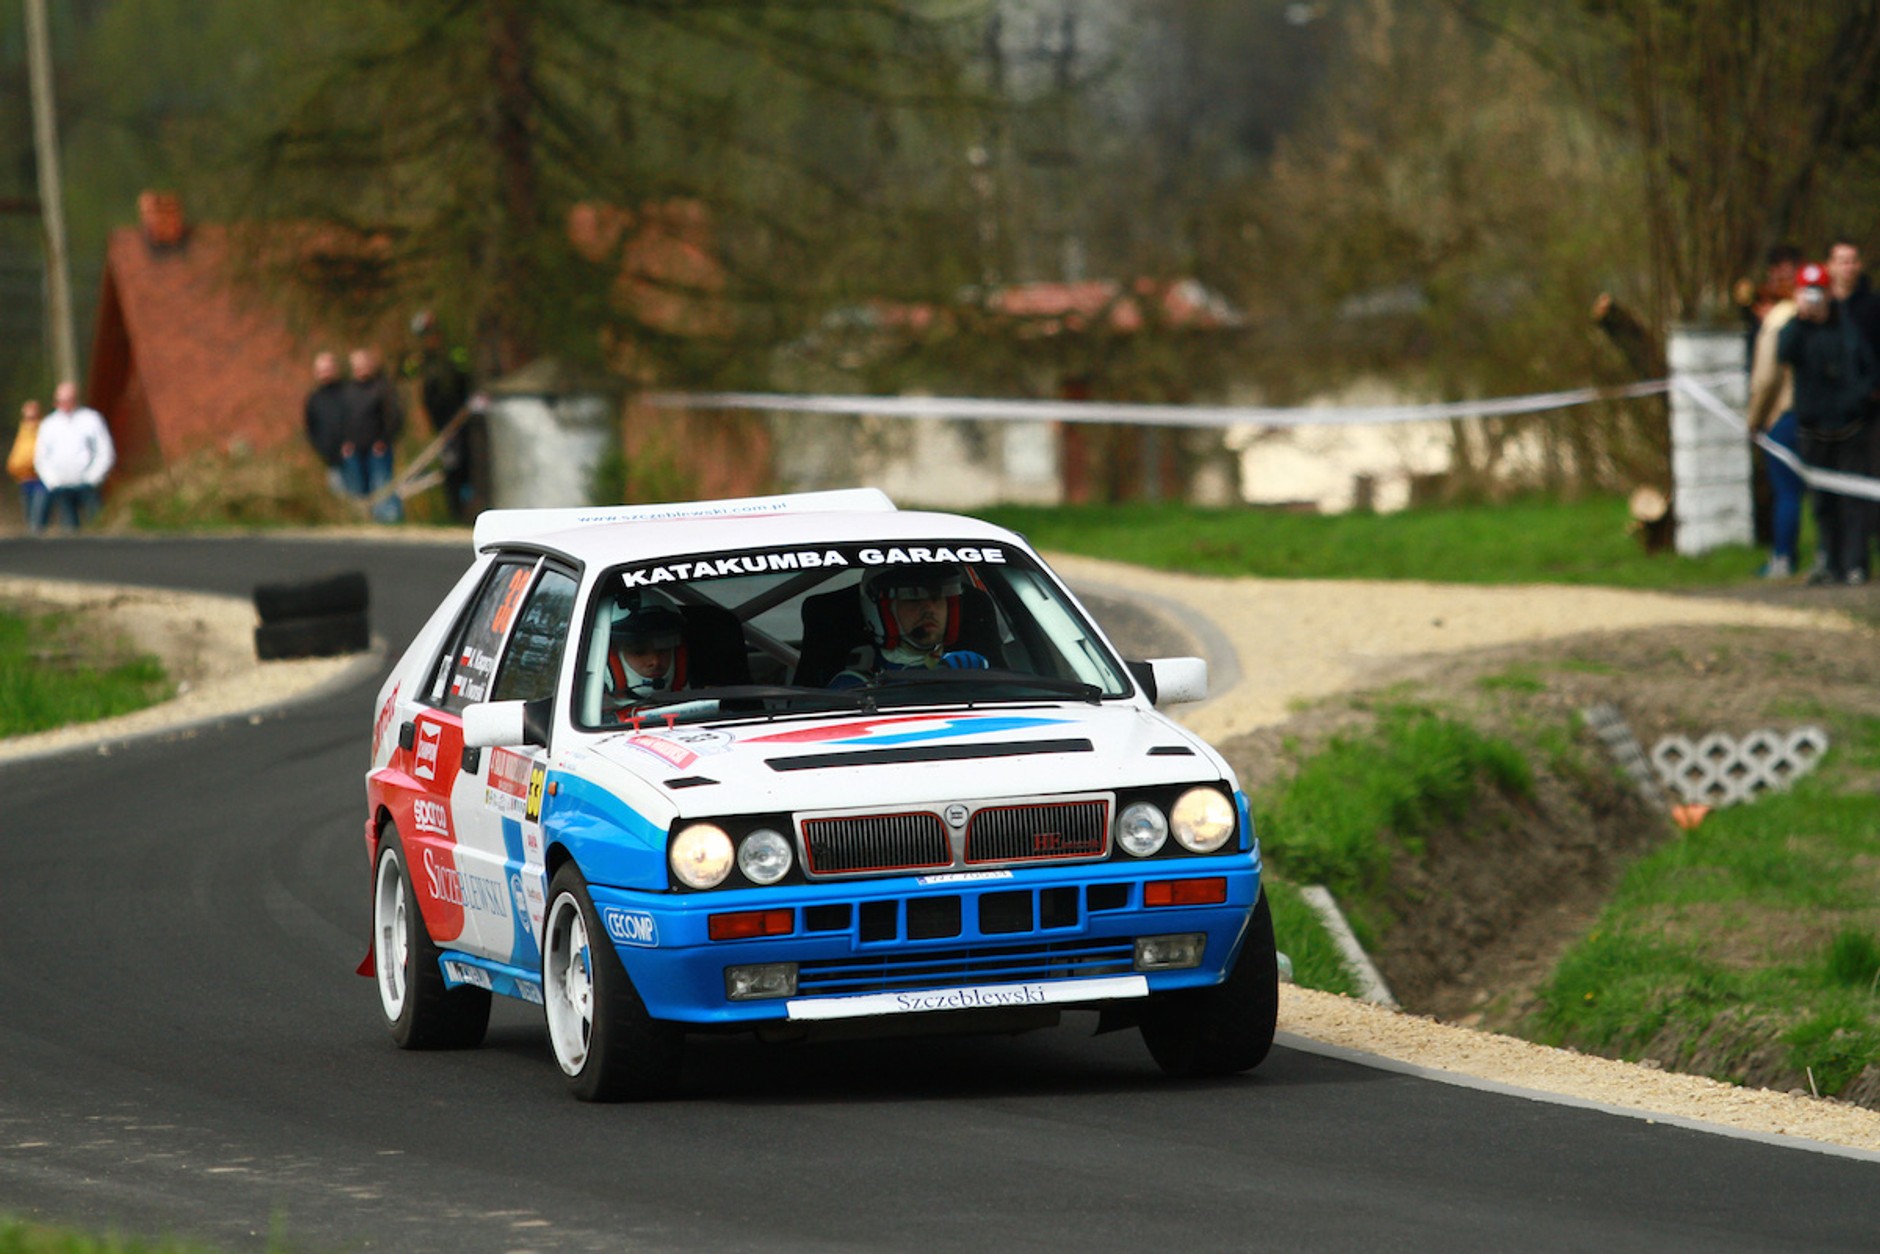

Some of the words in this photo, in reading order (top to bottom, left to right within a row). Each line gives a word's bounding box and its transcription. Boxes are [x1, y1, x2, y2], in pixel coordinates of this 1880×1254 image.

[577, 502, 787, 522] www.szczeblewski.com.pl
[621, 549, 848, 588] KATAKUMBA
[858, 548, 1006, 564] GARAGE
[414, 799, 447, 832] sparco
[1033, 832, 1061, 851] HF
[608, 912, 653, 941] CECOMP
[896, 985, 1046, 1011] Szczeblewski
